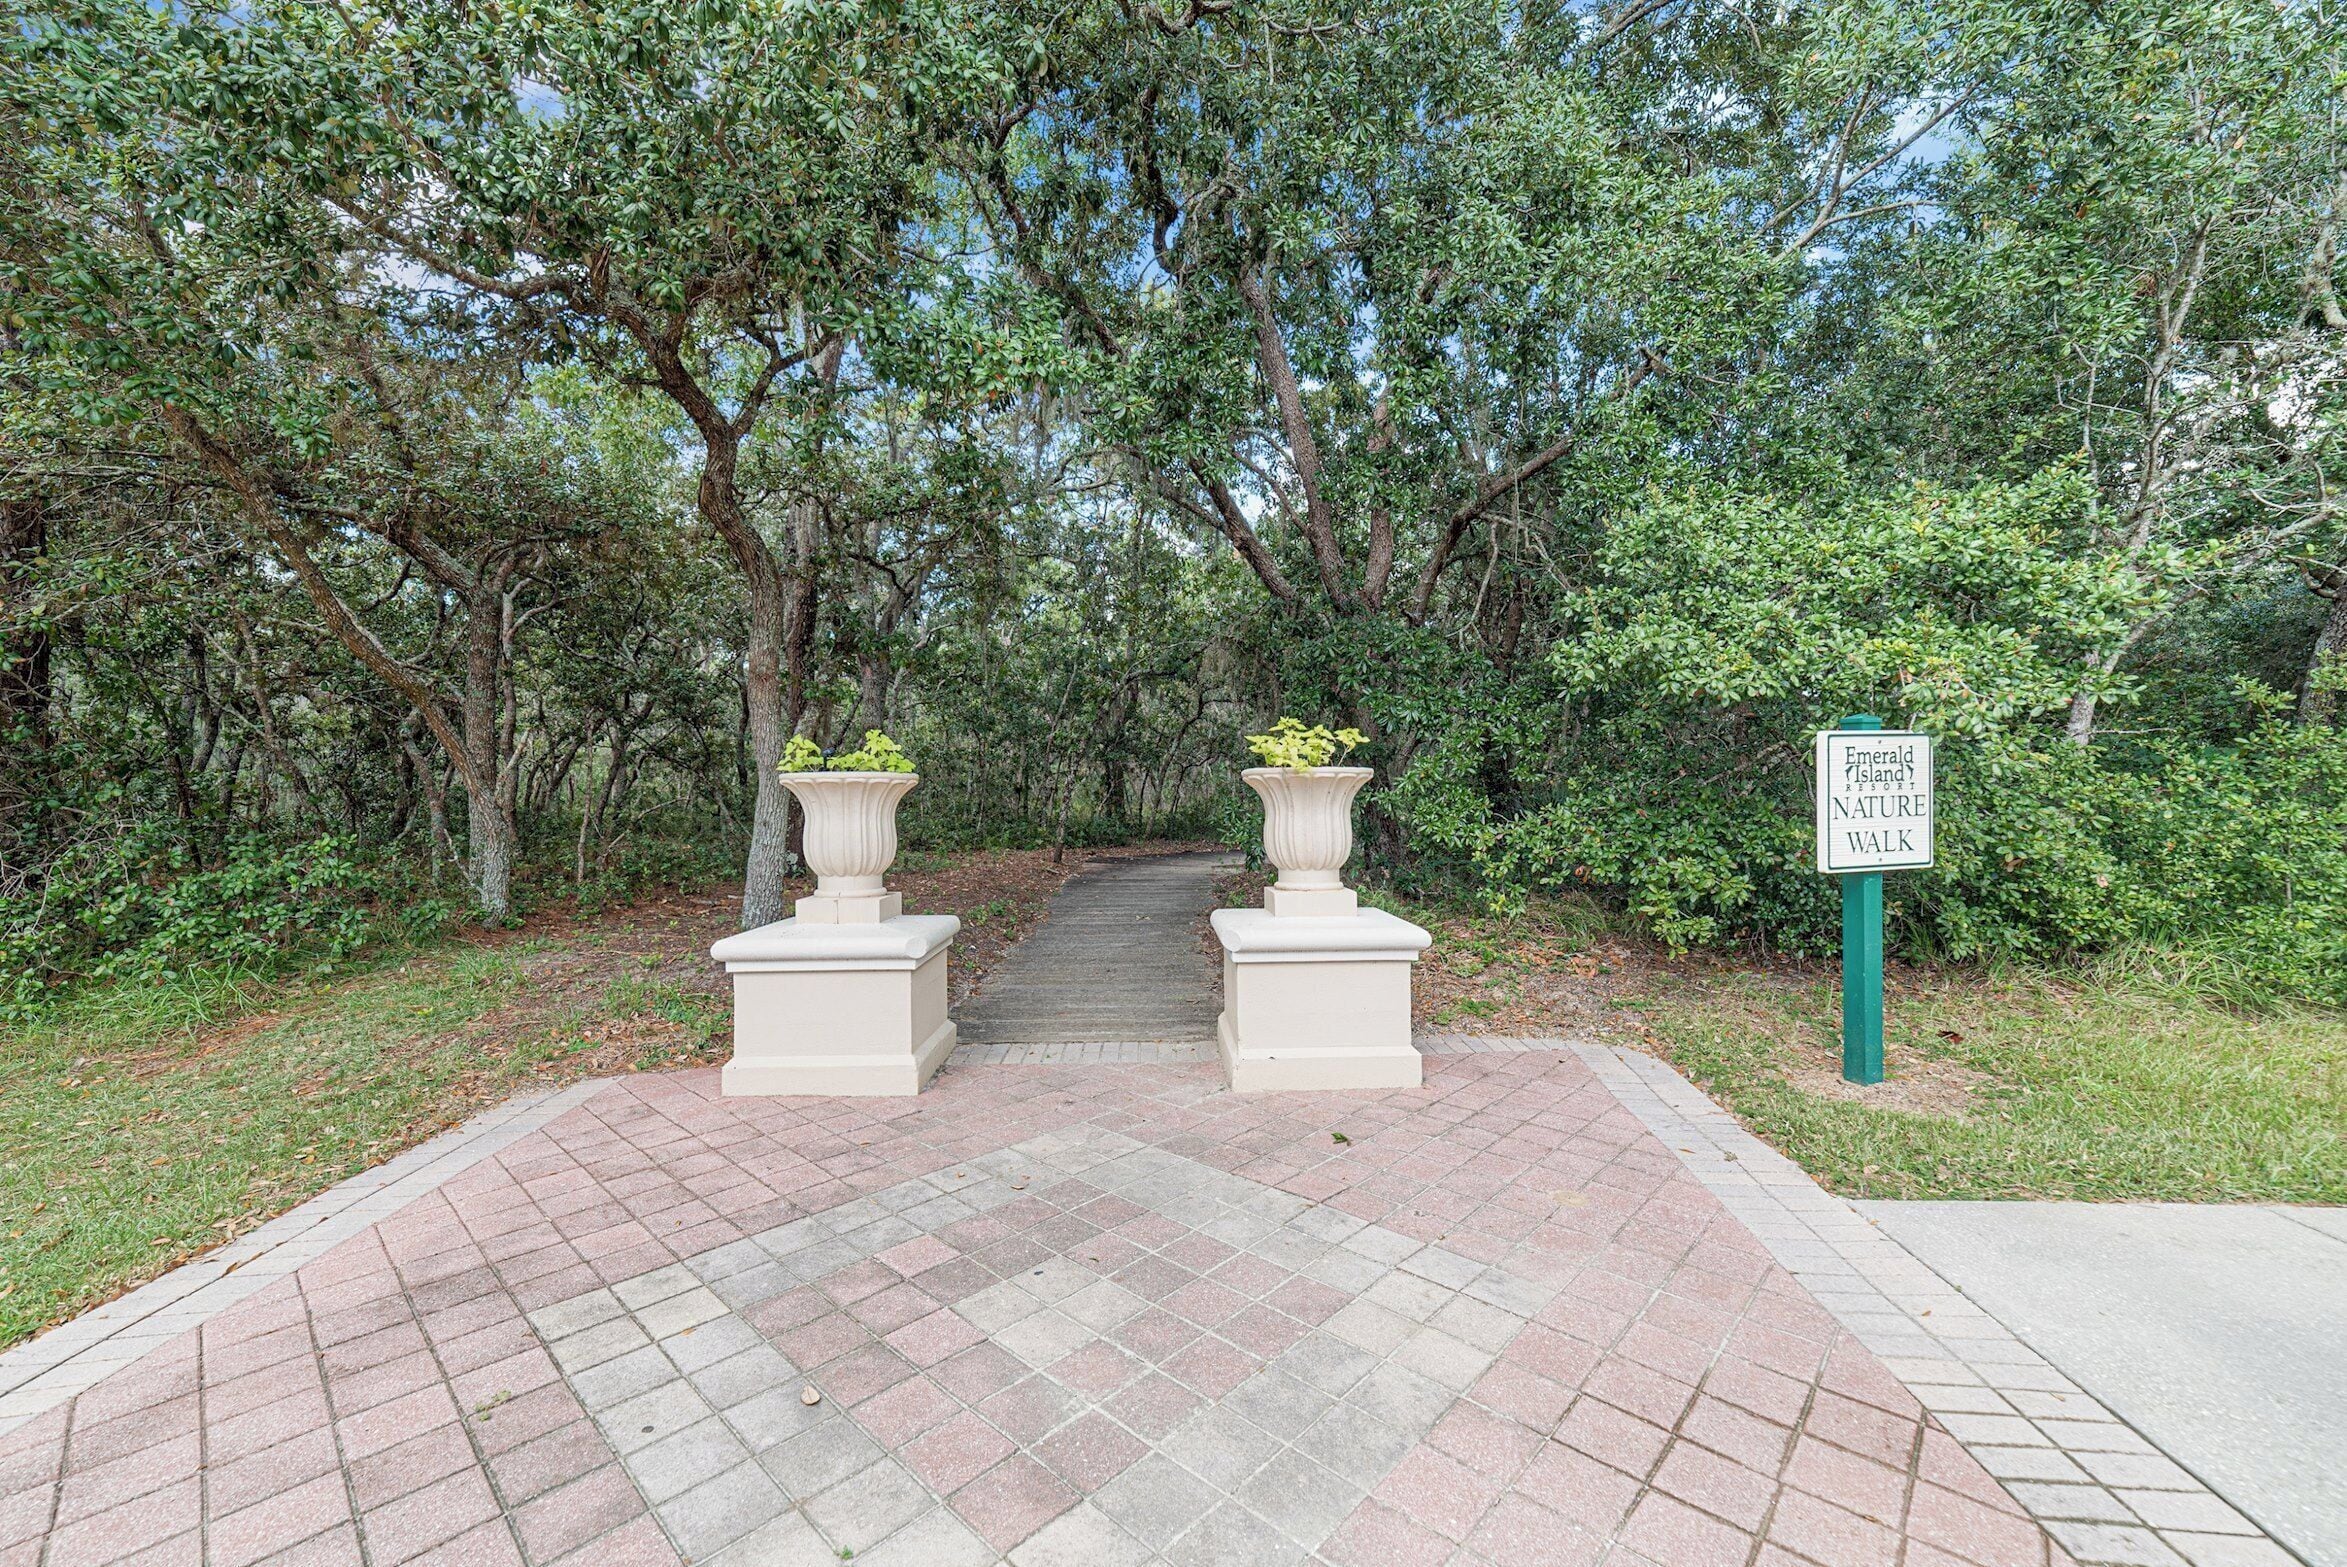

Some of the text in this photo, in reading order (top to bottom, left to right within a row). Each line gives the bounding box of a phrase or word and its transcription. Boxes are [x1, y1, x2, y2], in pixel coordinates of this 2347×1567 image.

[1845, 745, 1914, 765] Emerald
[1854, 764, 1905, 783] Island
[1845, 782, 1916, 792] RESORT
[1833, 794, 1927, 820] NATURE
[1847, 829, 1915, 854] WALK
